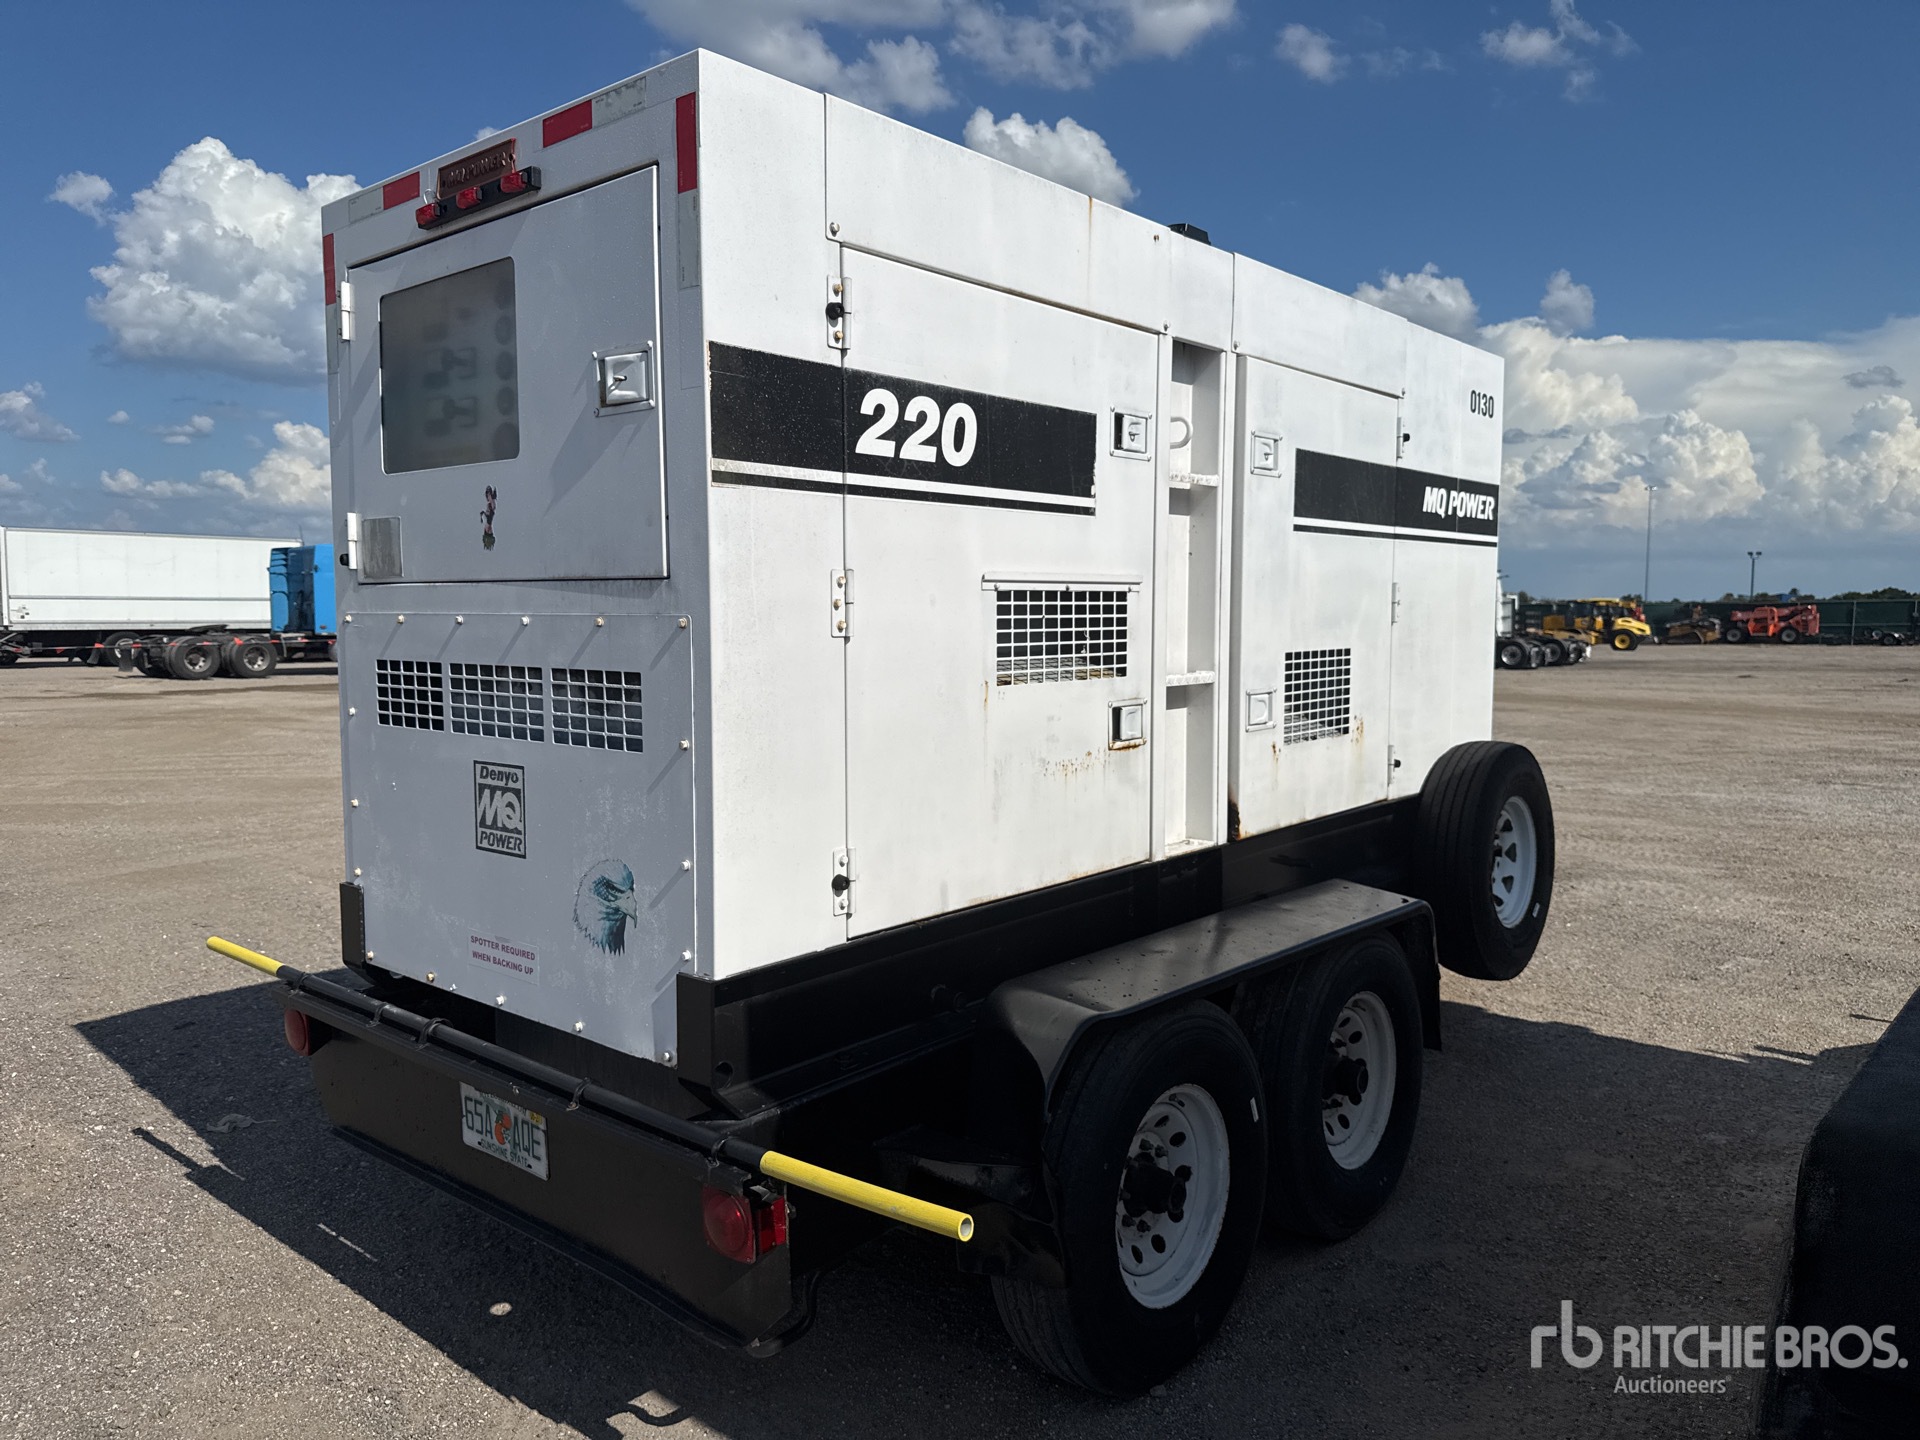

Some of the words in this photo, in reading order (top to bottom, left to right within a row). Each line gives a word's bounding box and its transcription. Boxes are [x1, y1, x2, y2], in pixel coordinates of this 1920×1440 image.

[1470, 389, 1495, 418] 0130
[855, 388, 978, 467] 220
[1422, 486, 1448, 519] MQ
[1448, 490, 1495, 521] POWER
[480, 766, 519, 786] Denyo
[478, 788, 522, 832] MQ
[480, 830, 523, 852] POWER
[470, 935, 500, 951] SPOTTER
[501, 944, 536, 961] REQUIRED
[472, 950, 491, 963] WHEN
[492, 956, 523, 973] BACKING
[524, 965, 534, 975] UP
[464, 1096, 494, 1140] 65A
[480, 1139, 508, 1159] SUNSHINE
[509, 1152, 529, 1168] STATE
